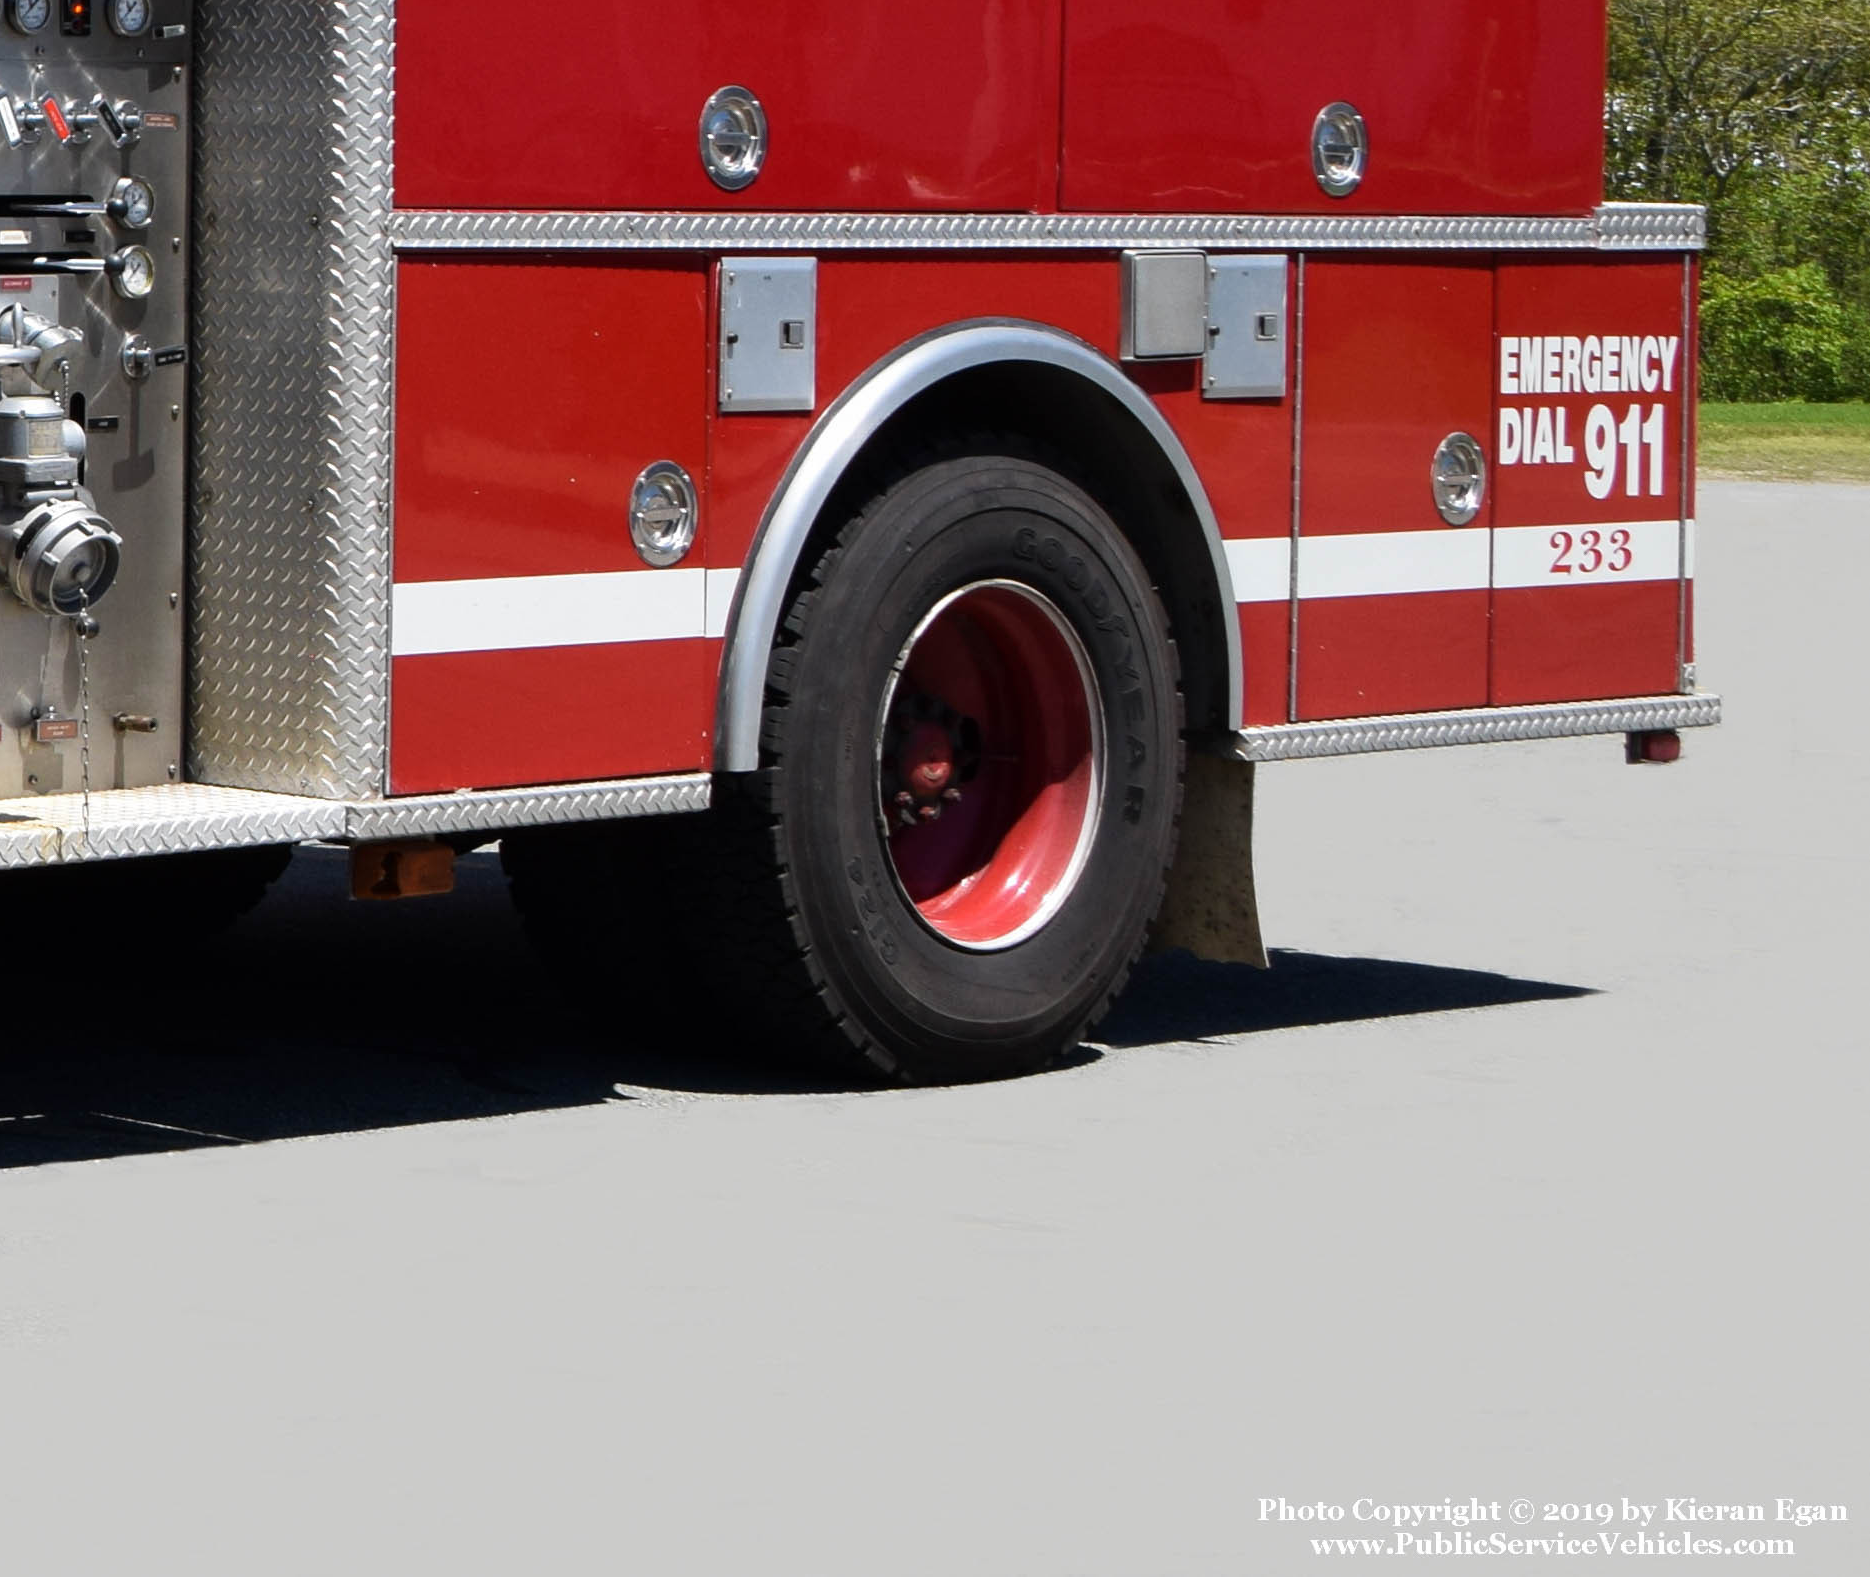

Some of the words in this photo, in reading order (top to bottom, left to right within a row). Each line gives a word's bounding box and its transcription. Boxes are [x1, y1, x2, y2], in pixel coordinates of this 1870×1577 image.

[1499, 335, 1680, 395] EMERGENCY
[1498, 406, 1574, 465] DIAL
[1583, 402, 1665, 500] 911
[1549, 528, 1634, 576] 233
[1012, 525, 1147, 826] GOODYEAR
